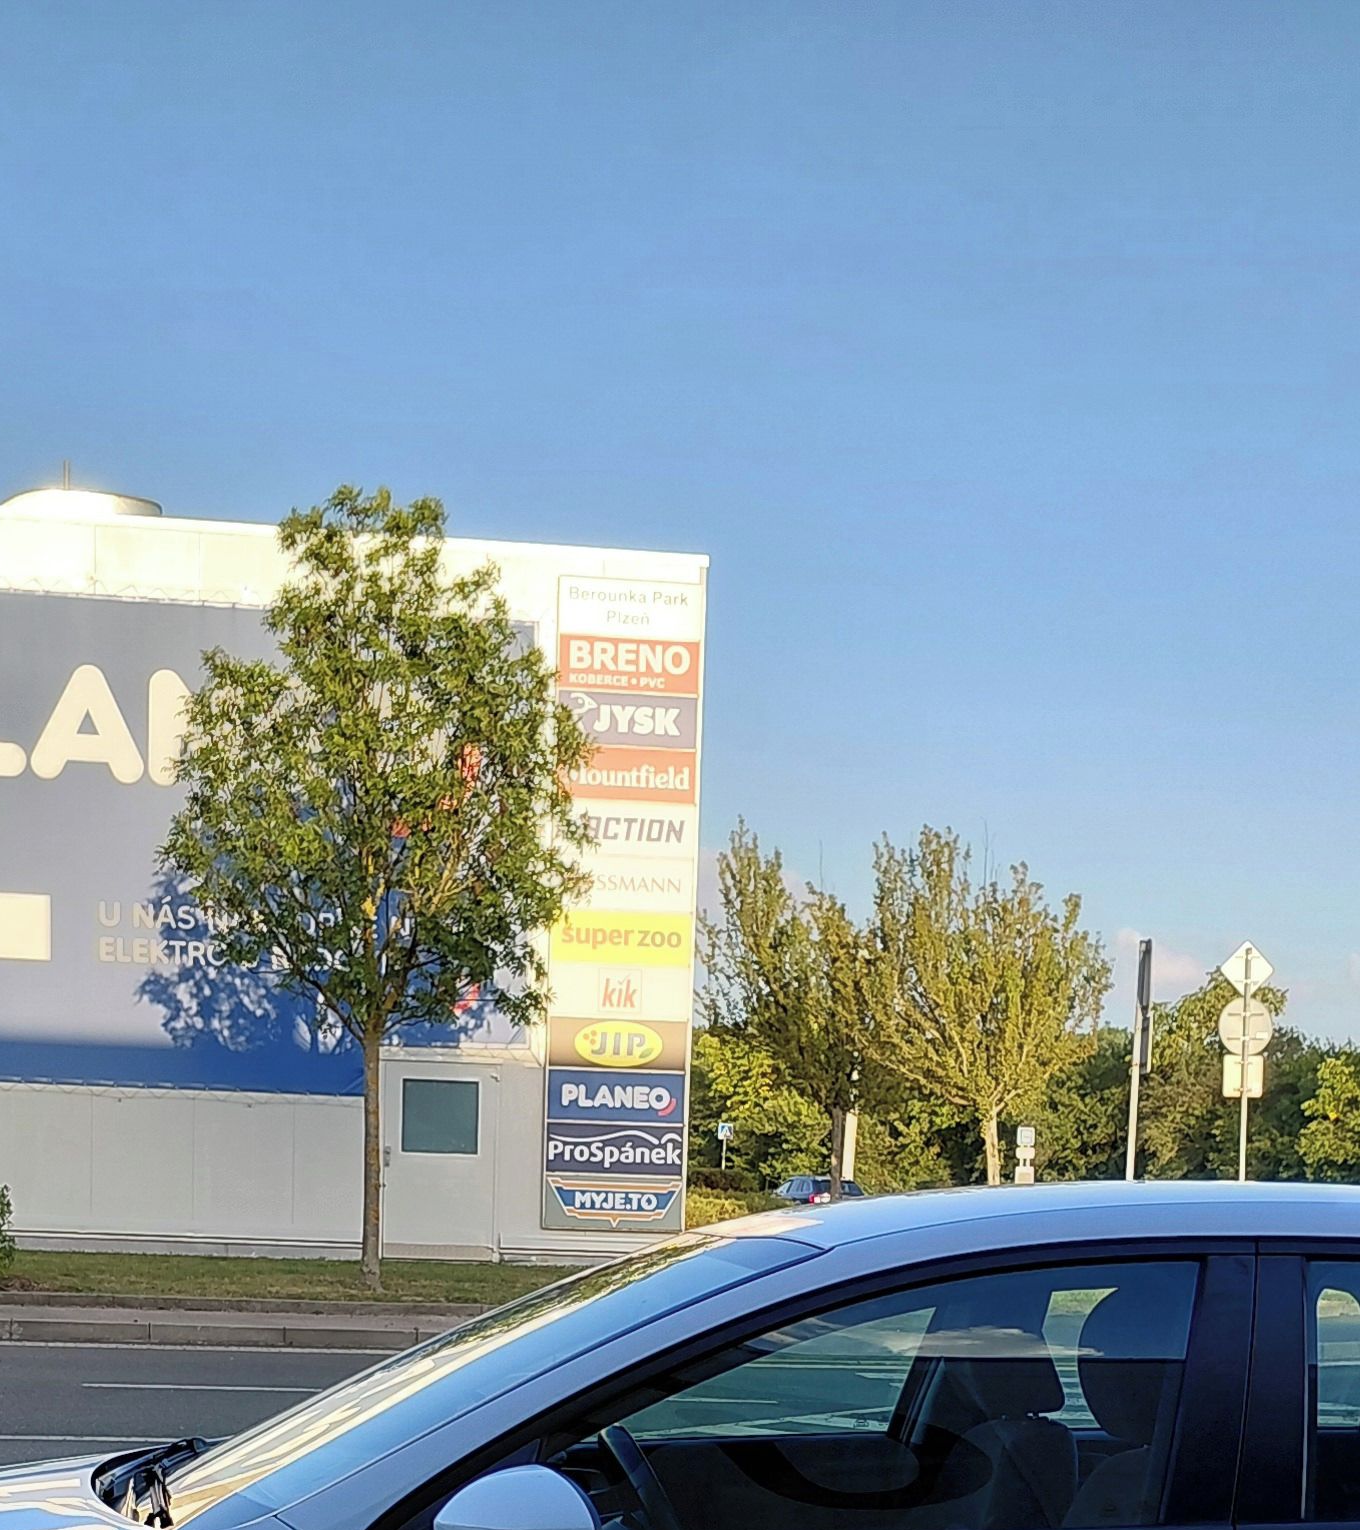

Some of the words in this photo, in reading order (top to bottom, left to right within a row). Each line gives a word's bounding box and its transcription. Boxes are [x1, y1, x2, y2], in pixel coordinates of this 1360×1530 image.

[569, 586, 646, 604] Berounka
[653, 591, 688, 606] Park
[569, 639, 690, 675] BRENO
[569, 673, 628, 686] KOBERCE
[640, 677, 665, 688] PVC
[593, 704, 681, 736] JYSK
[596, 874, 681, 893] SSMANN
[99, 901, 121, 928] U
[132, 896, 196, 930] NÁS
[562, 927, 634, 950] super
[637, 930, 682, 948] zoo
[602, 977, 638, 1008] kik
[591, 1032, 646, 1056] JIP
[561, 1083, 671, 1109] PLANEO
[548, 1141, 682, 1168] ProSpánek
[574, 1191, 658, 1210] MYJE.TO
